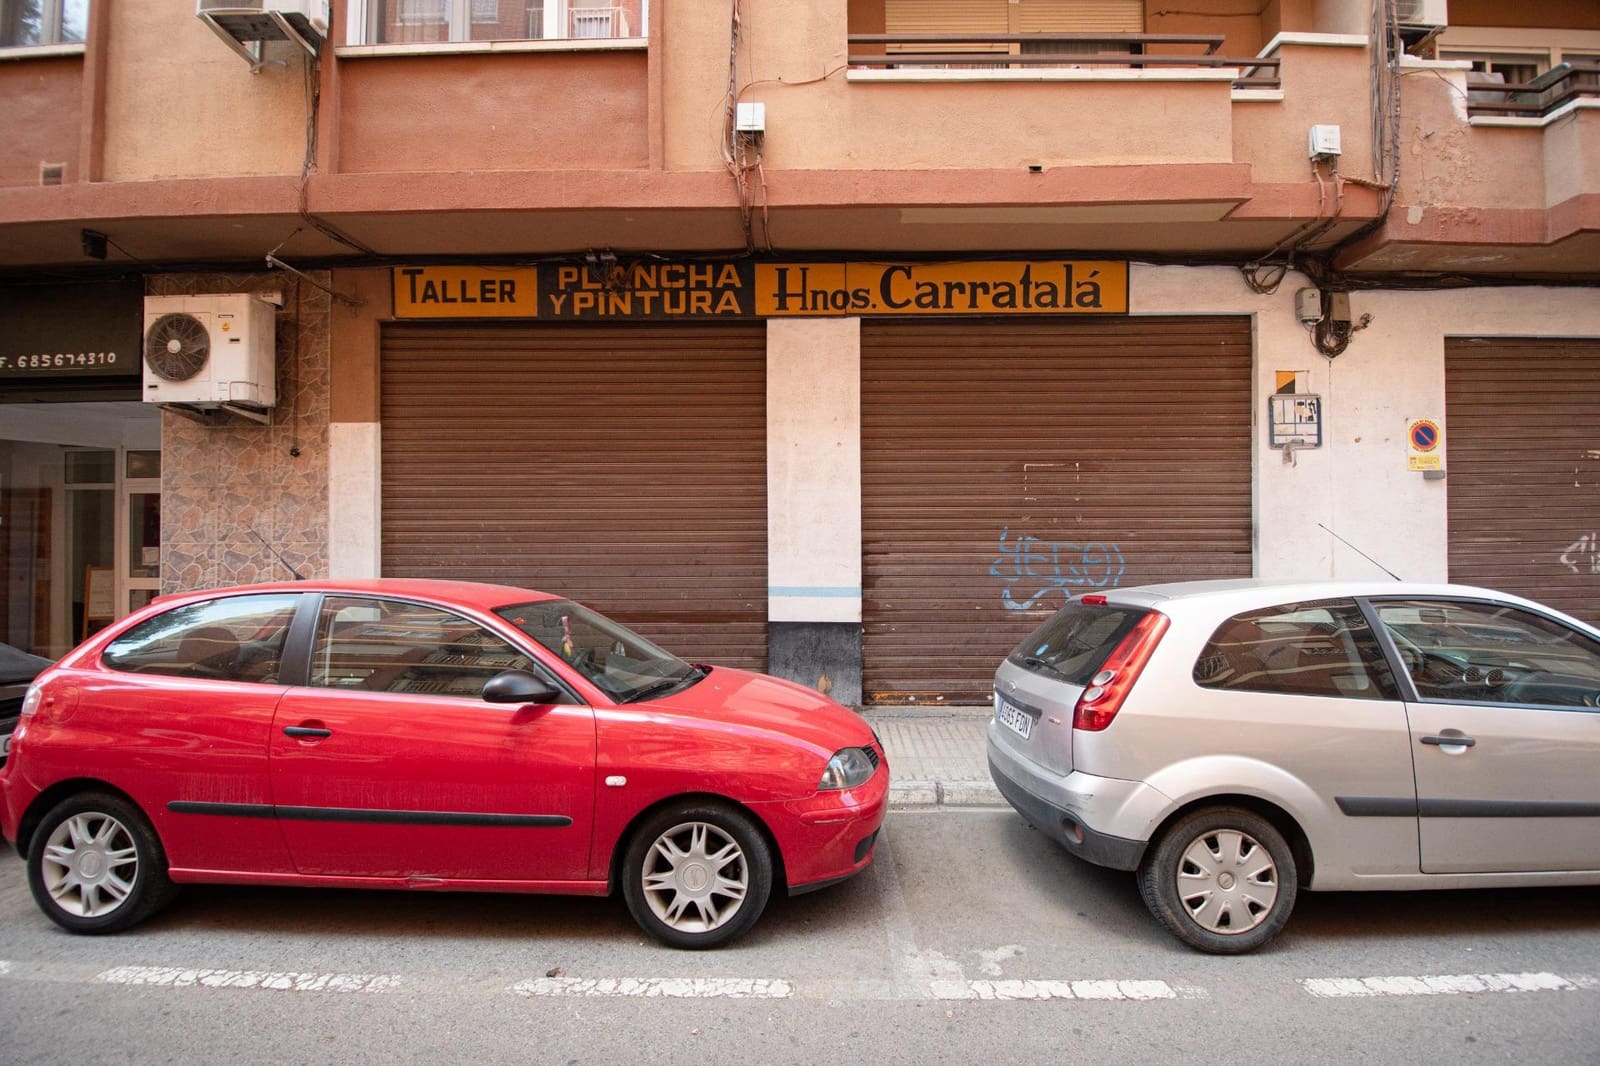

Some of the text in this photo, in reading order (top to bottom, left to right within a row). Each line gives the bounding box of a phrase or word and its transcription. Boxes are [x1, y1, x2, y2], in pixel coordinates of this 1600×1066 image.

[402, 268, 517, 303] TALLER
[772, 264, 1103, 311] Hnos. Carratalá
